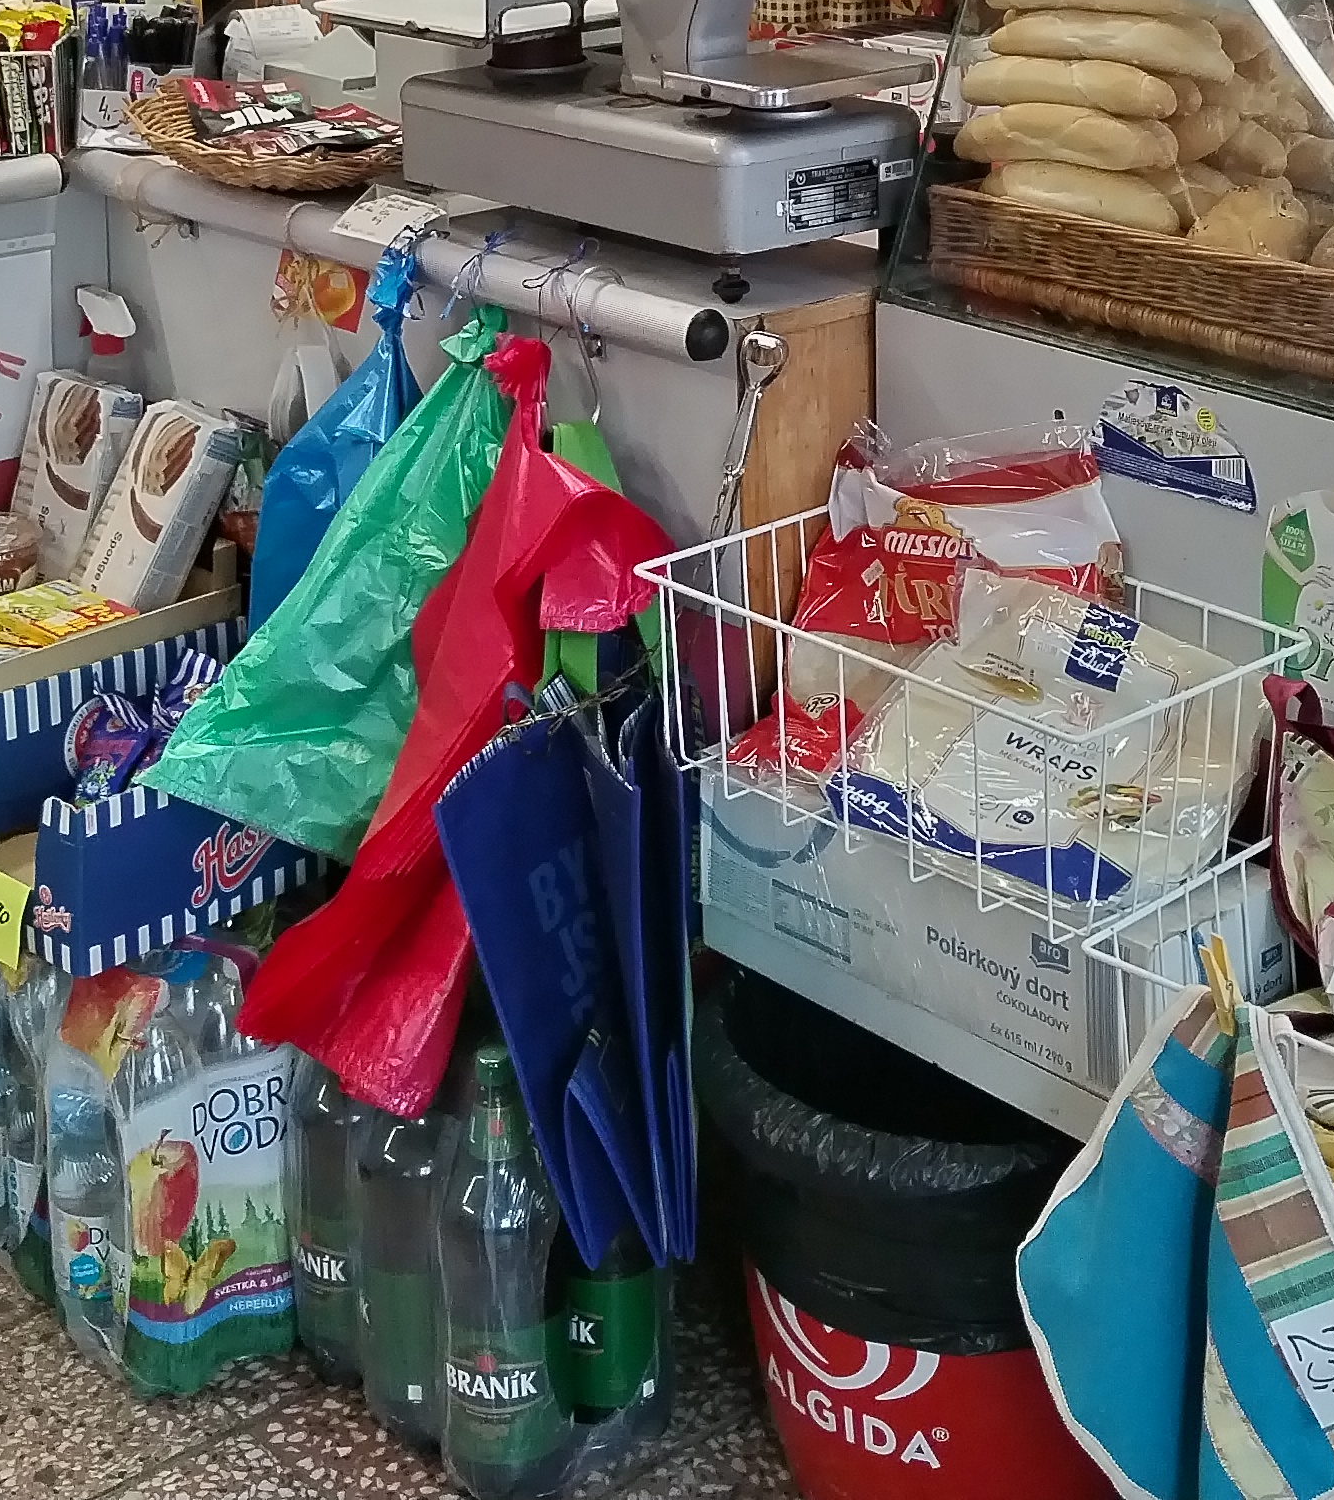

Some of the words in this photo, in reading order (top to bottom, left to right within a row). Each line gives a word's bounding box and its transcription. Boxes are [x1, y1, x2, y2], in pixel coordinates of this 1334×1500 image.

[925, 924, 1021, 990] Polárkový
[1025, 975, 1071, 1012] dort
[1039, 941, 1061, 960] aro
[996, 988, 1071, 1034] ČOKOLÁDOVÝ
[444, 1359, 538, 1401] BRANÍK
[767, 1352, 942, 1470] ALGIDA
